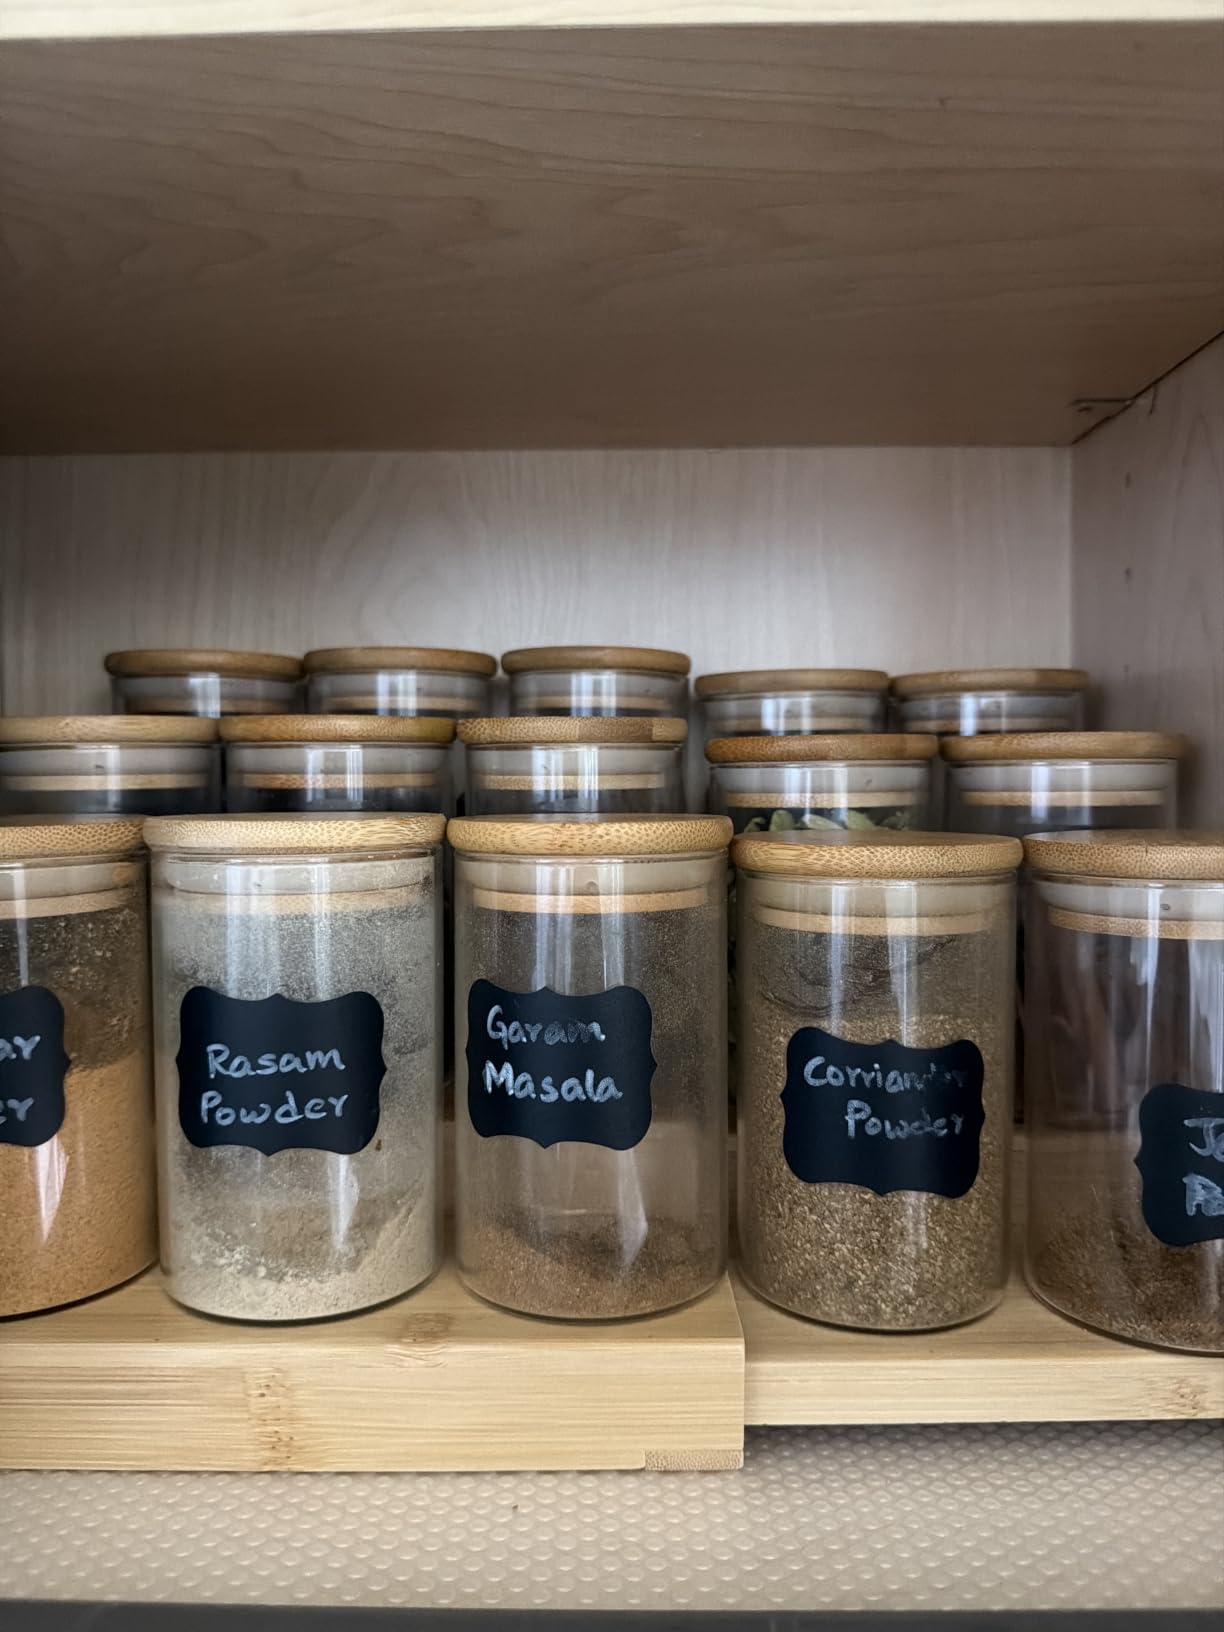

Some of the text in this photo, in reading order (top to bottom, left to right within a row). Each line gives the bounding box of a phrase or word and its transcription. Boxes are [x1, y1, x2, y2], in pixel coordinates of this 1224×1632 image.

[486, 1004, 606, 1050] Garam
[206, 1043, 346, 1079] Rasam
[482, 1060, 623, 1102] Masala
[201, 1090, 348, 1126] Powder
[845, 1099, 965, 1139] Powder
